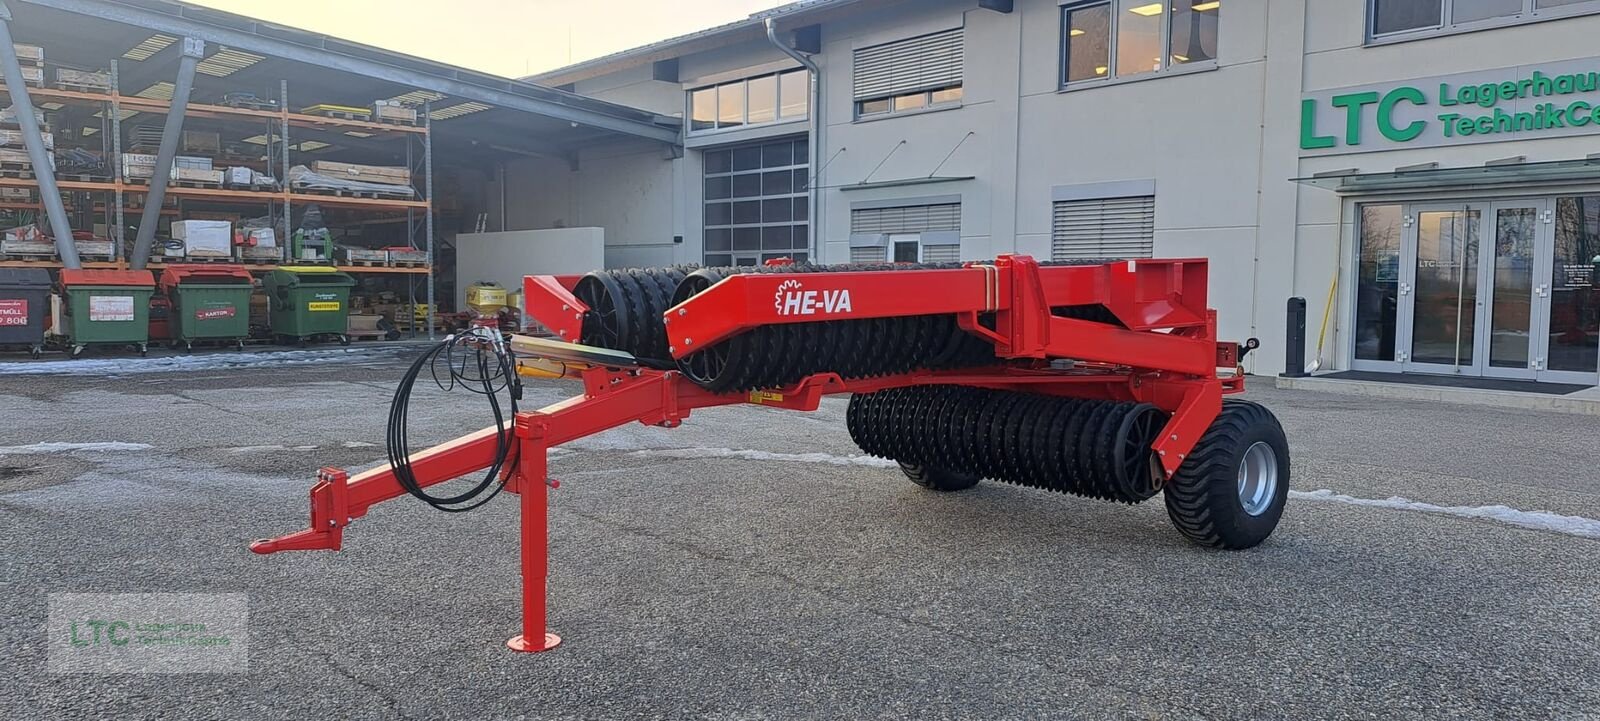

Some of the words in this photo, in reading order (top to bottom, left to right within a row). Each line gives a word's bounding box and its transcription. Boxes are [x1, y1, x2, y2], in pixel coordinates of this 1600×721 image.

[1439, 71, 1600, 107] Lagerhau
[1301, 87, 1427, 149] LTC
[1419, 260, 1435, 268] LTC
[783, 289, 852, 315] HE-VA
